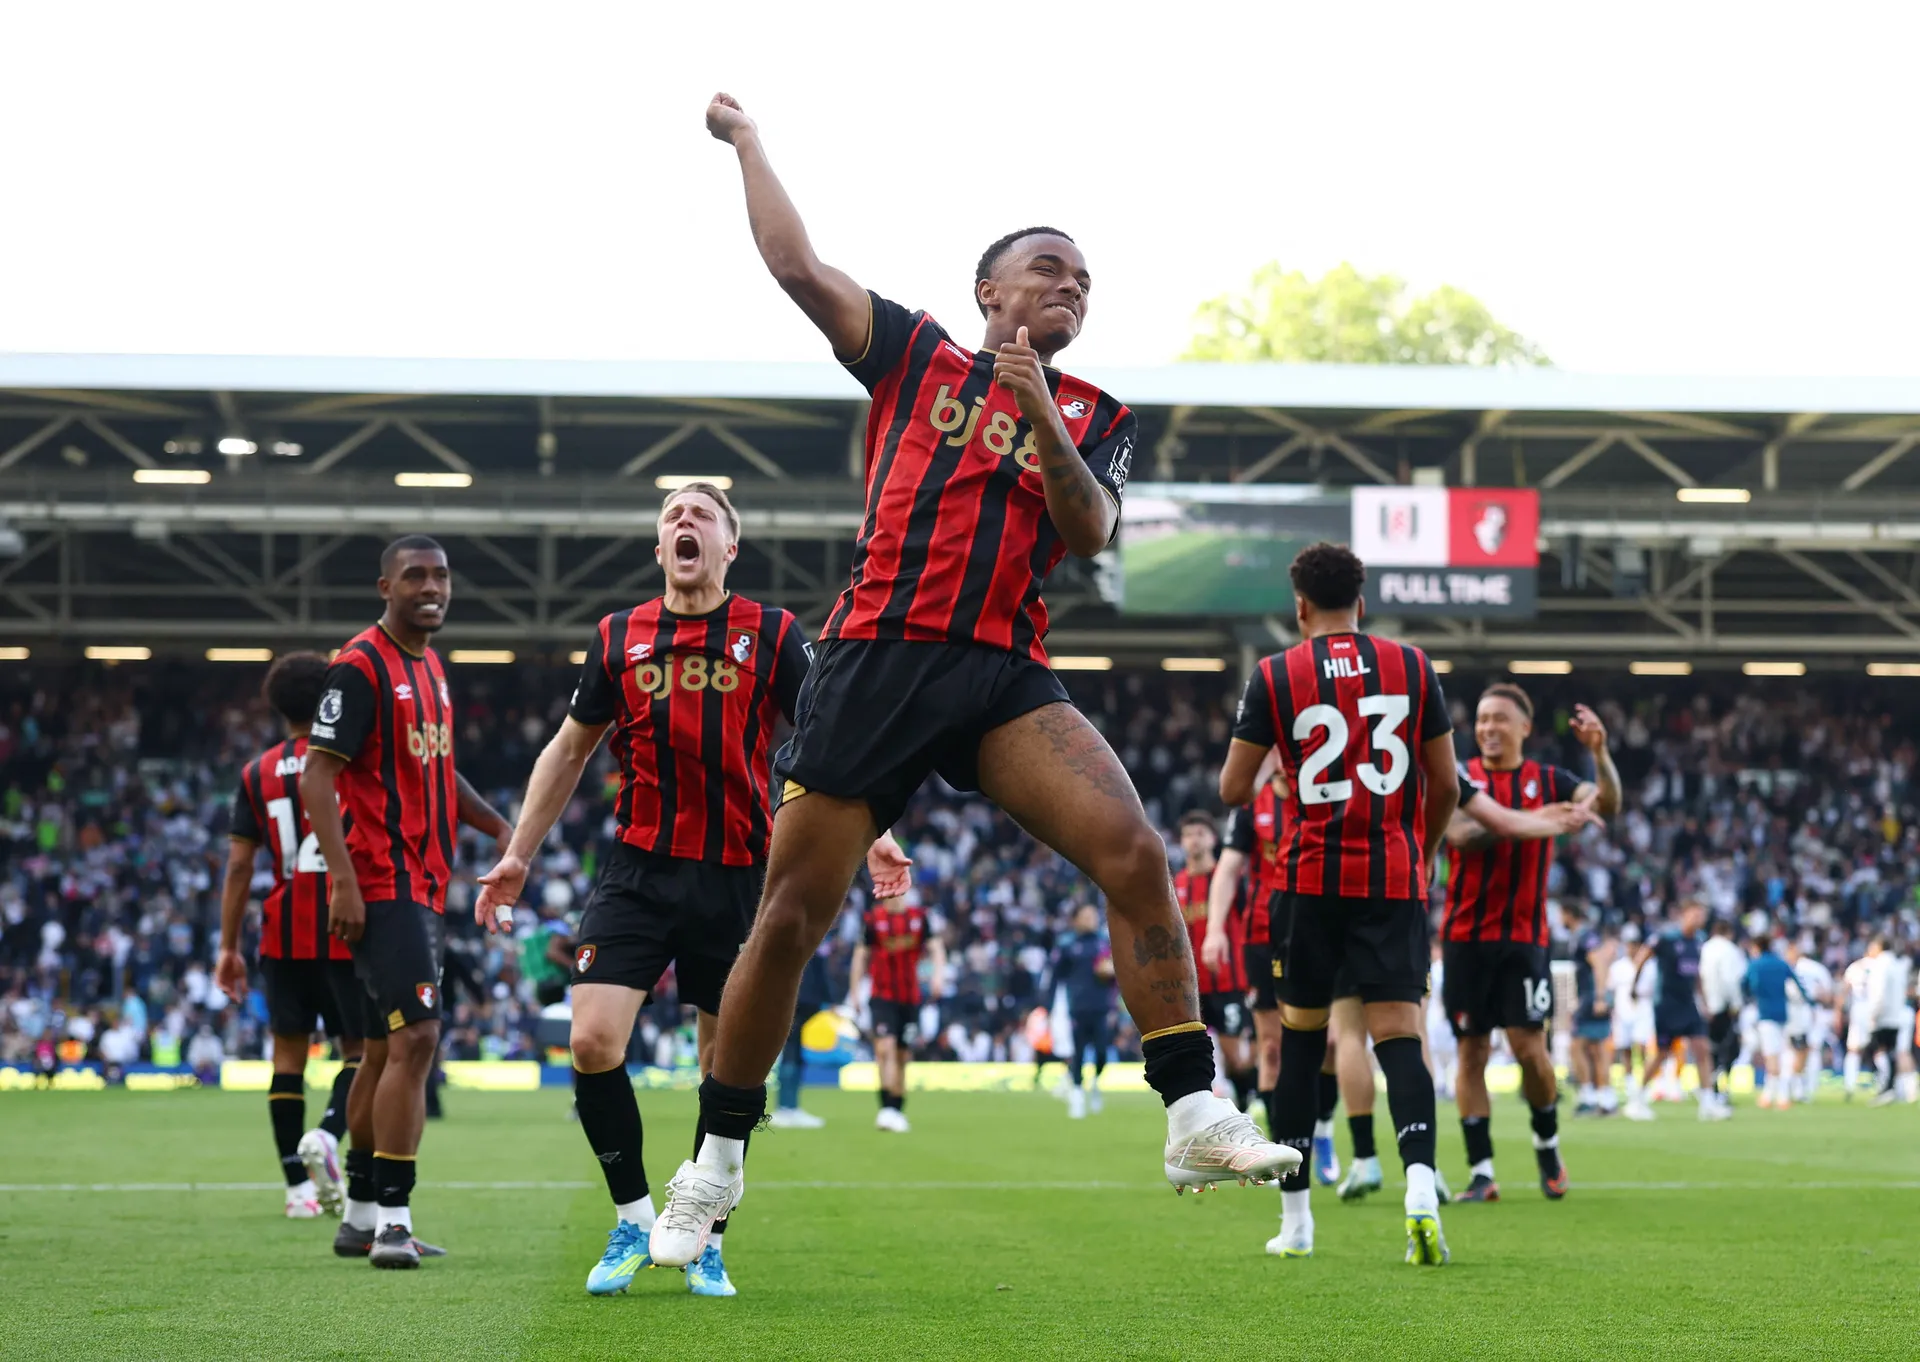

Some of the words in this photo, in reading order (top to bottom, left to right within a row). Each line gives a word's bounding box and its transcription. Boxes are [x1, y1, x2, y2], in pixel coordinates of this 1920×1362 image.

[929, 384, 1041, 473] bj88
[1380, 573, 1446, 604] FULL
[1446, 573, 1511, 605] TIME
[635, 654, 740, 700] bj88
[1323, 655, 1371, 679] HILL
[407, 721, 450, 765] bj88
[1292, 694, 1410, 805] 23
[1523, 977, 1551, 1012] 16
